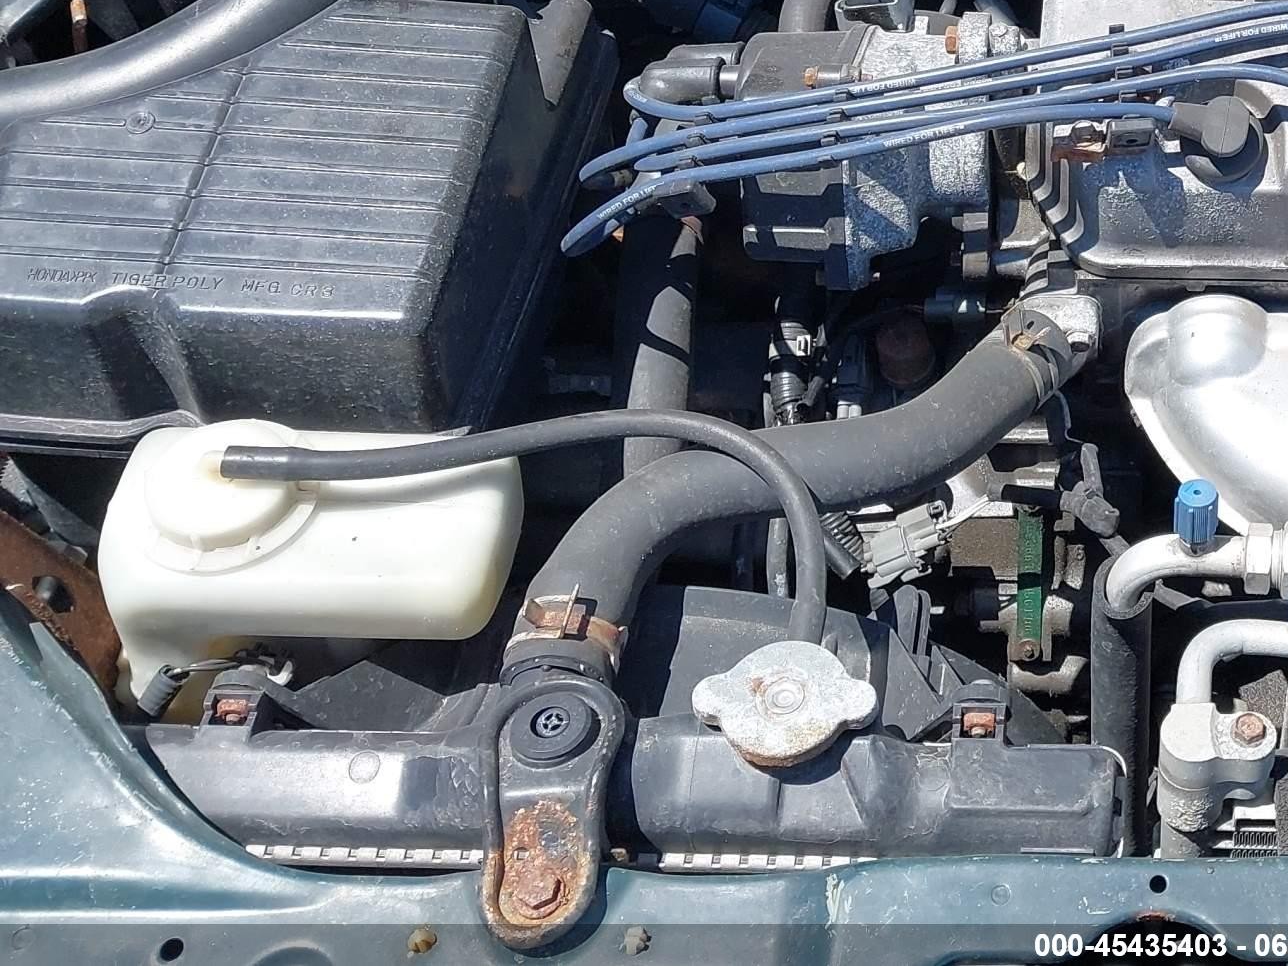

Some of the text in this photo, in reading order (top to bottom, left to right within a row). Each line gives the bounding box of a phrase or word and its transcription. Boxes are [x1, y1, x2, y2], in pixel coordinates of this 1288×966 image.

[1241, 27, 1260, 37] FOR
[1261, 24, 1288, 35] WIRED
[870, 80, 892, 92] FOR
[893, 78, 916, 89] WIRED
[883, 136, 914, 147] WIRED
[914, 132, 934, 143] FOR
[598, 202, 621, 219] WIRED
[622, 193, 640, 208] FOR
